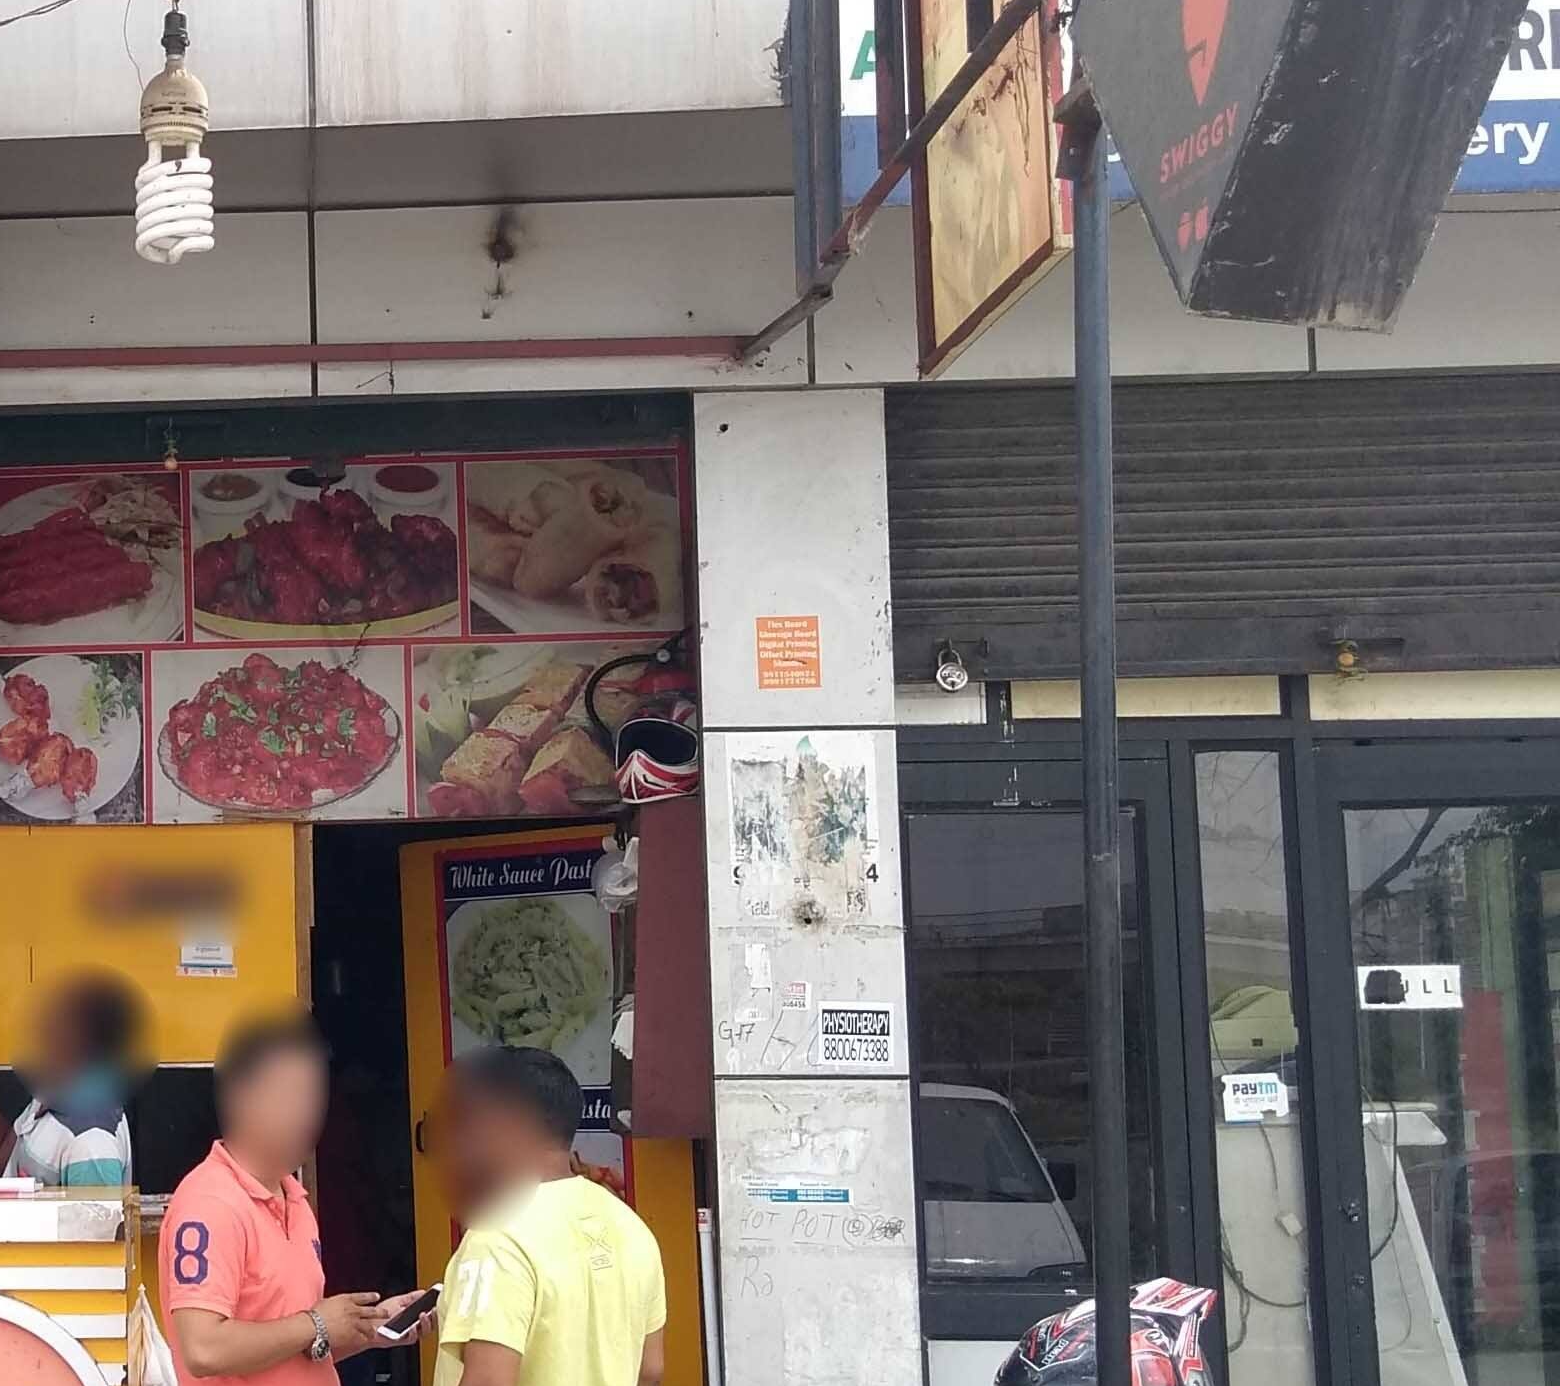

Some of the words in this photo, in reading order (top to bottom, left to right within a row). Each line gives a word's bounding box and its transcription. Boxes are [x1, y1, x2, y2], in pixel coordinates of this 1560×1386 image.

[1159, 101, 1239, 184] SWIGGY
[450, 863, 495, 889] White
[499, 862, 545, 885] Sauce
[549, 857, 593, 887] Past
[822, 1012, 890, 1035] PHYSIOTHERAPY
[823, 1037, 889, 1062] 8800673388
[172, 1221, 211, 1285] 8
